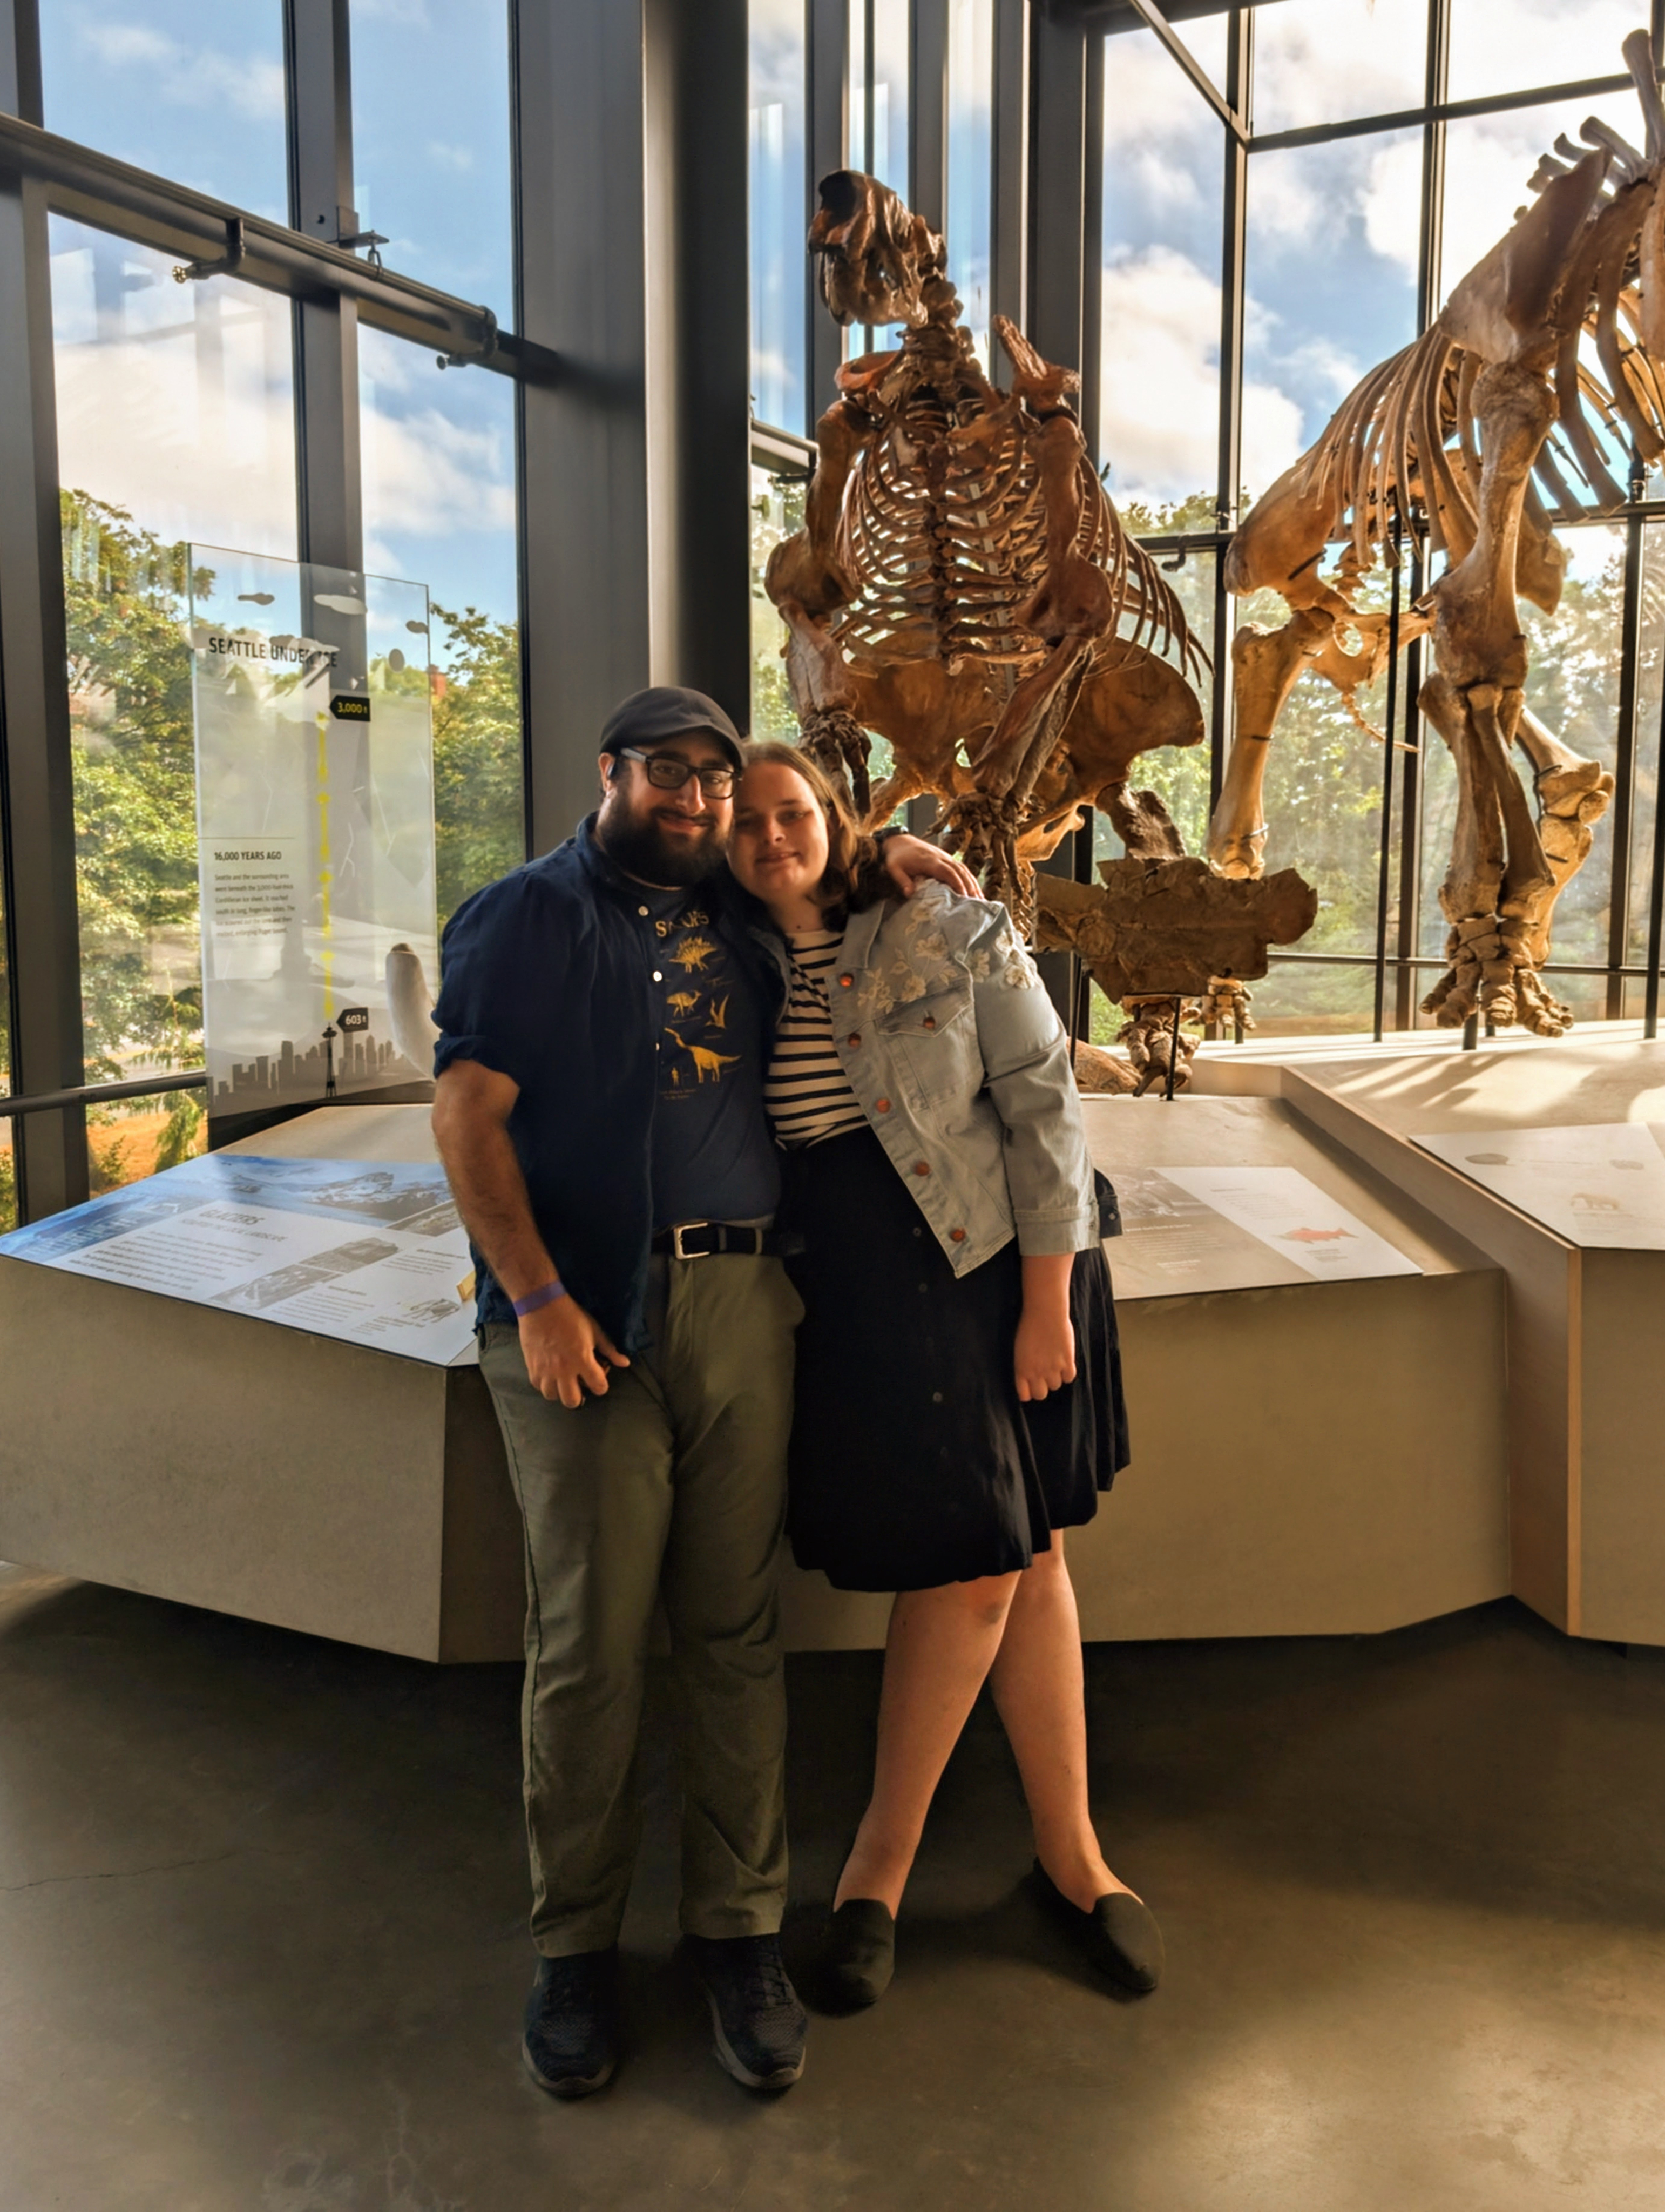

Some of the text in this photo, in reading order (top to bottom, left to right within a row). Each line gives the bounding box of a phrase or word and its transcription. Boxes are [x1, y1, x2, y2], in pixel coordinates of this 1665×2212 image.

[209, 637, 266, 659] SEATTLE
[337, 702, 362, 713] 3,000
[214, 851, 282, 861] 16,000 YEARS AGO
[346, 1015, 361, 1025] 603
